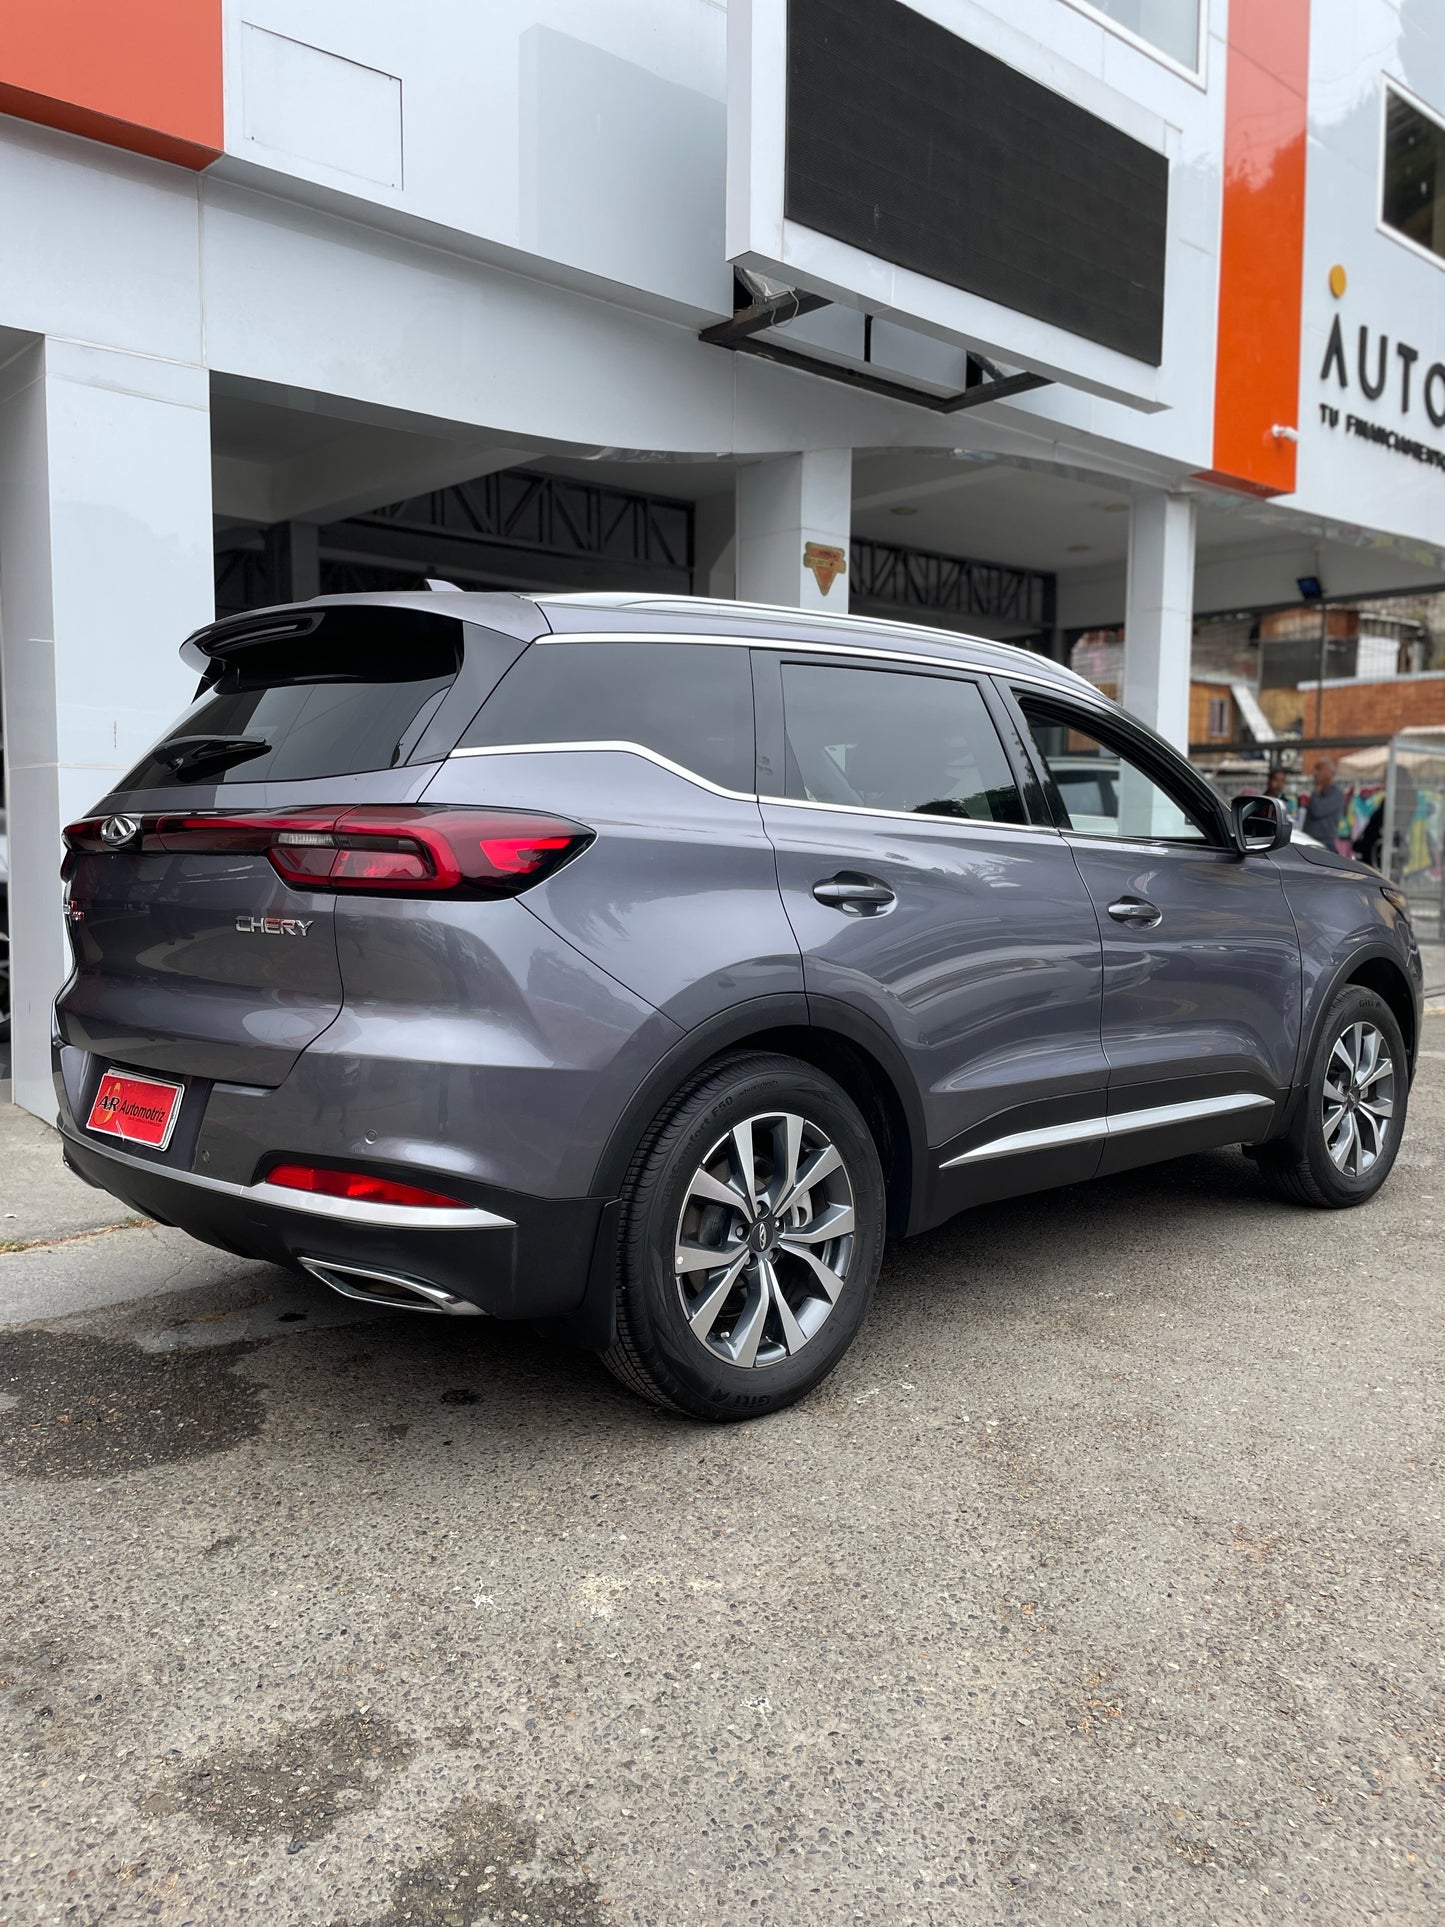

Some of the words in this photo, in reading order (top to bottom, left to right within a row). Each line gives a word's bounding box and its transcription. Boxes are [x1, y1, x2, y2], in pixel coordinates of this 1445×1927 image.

[1319, 403, 1339, 428] TU
[235, 915, 314, 937] CHERY
[119, 1099, 166, 1123] Automotriz
